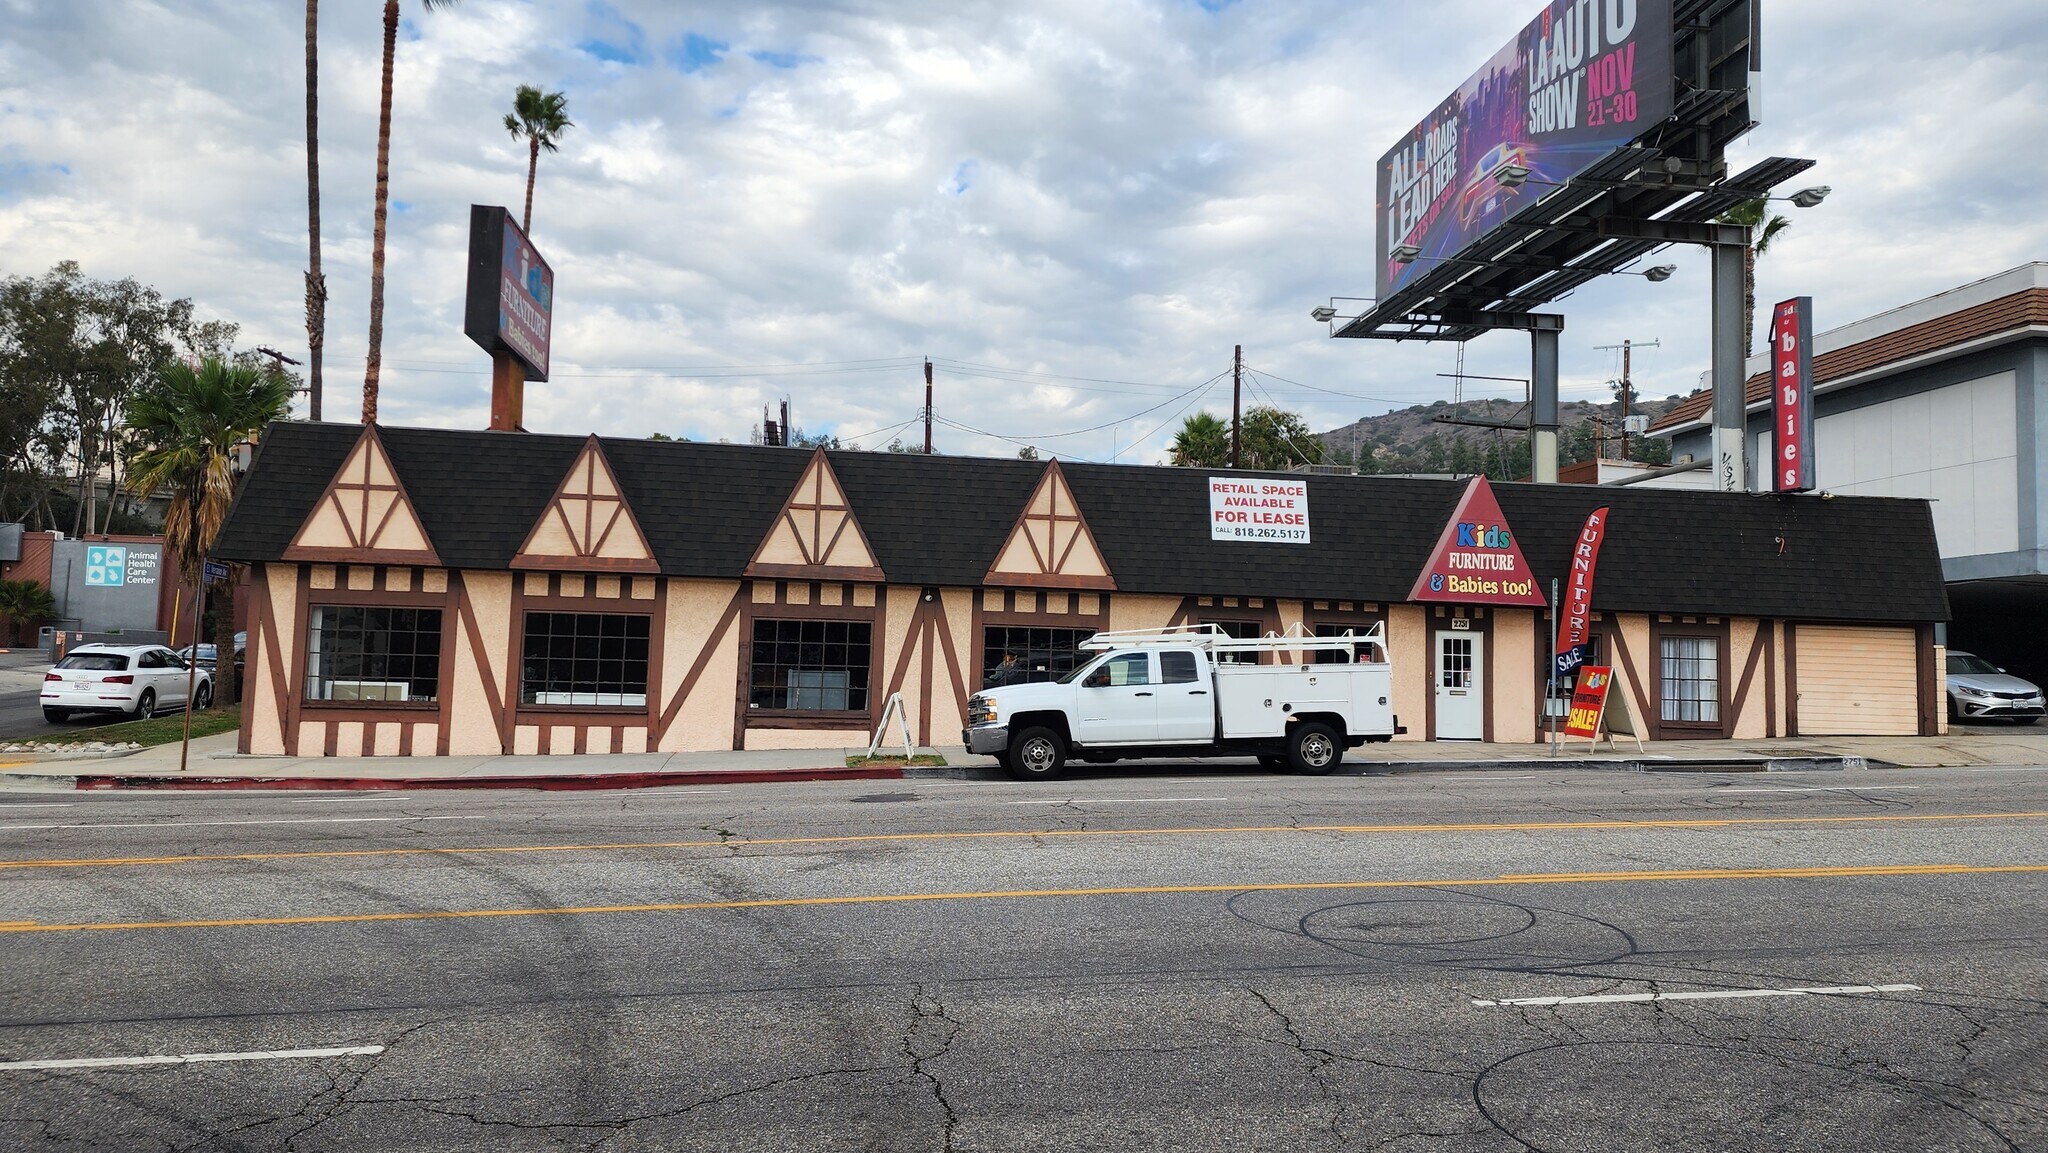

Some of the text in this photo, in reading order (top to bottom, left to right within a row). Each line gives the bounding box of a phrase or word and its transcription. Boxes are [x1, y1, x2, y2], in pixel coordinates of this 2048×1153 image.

[1529, 0, 1637, 94] LA AUTO
[1587, 41, 1636, 102] NOV
[1528, 70, 1580, 134] SHOW
[1587, 90, 1637, 126] 21-30
[1389, 116, 1458, 208] ALL ROADS
[1388, 145, 1458, 260] LEAD HERE
[1429, 198, 1441, 225] ON
[1441, 175, 1457, 210] SALE
[503, 223, 549, 313] Kids
[503, 277, 547, 342] FURNITURE
[508, 317, 532, 356] Babies
[532, 343, 546, 367] too!
[1782, 331, 1797, 486] babies
[1212, 483, 1304, 496] RETAIL SPACE
[1224, 497, 1294, 509] AVAILABLE
[1215, 511, 1305, 525] FOR LEASE
[1234, 527, 1306, 539] 818.262.5137
[1457, 523, 1511, 549] Kids
[128, 551, 158, 560] Animal
[128, 560, 156, 568] Health
[1449, 552, 1515, 571] FURNITURE
[126, 576, 156, 584] Center
[127, 568, 147, 576] Care
[1430, 573, 1445, 592] &
[1447, 575, 1499, 595] Babies
[1501, 578, 1533, 596] too!
[1569, 514, 1600, 643] FURNITURE
[1453, 619, 1469, 629] 2751
[1557, 647, 1583, 672] SALE
[1575, 692, 1602, 705] FURNITURE
[1844, 757, 1861, 766] 2751
